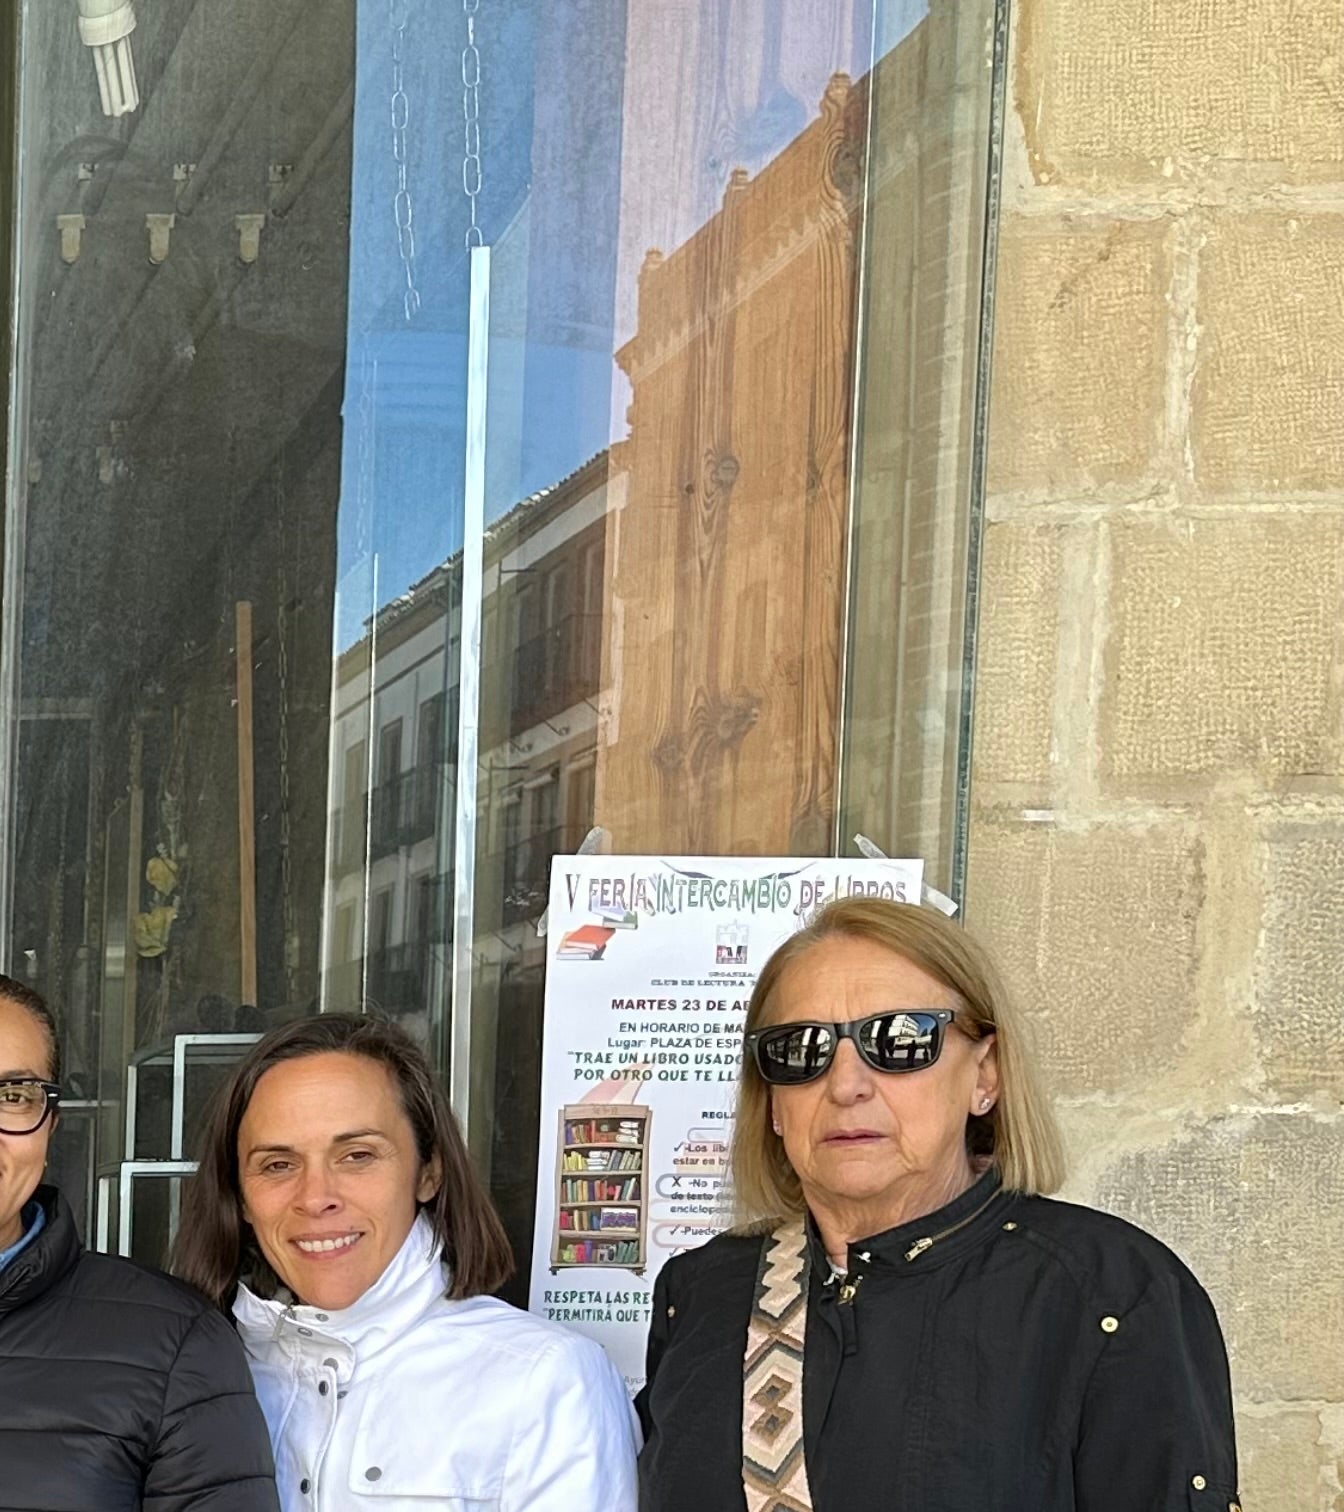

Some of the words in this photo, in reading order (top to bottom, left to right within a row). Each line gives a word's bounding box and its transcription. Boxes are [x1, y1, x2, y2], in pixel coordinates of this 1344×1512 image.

[611, 999, 678, 1011] MARTES
[682, 1000, 701, 1011] 23
[706, 1000, 728, 1011] DE
[619, 1053, 638, 1064] UN
[642, 1053, 689, 1065] LIBRO
[574, 1069, 605, 1080] POR
[610, 1070, 652, 1081] OTRO
[657, 1069, 690, 1082] QUE
[695, 1070, 711, 1081] TE
[544, 1291, 602, 1303] RESPETA
[606, 1291, 630, 1303] LAS
[616, 1310, 640, 1322] QUE
